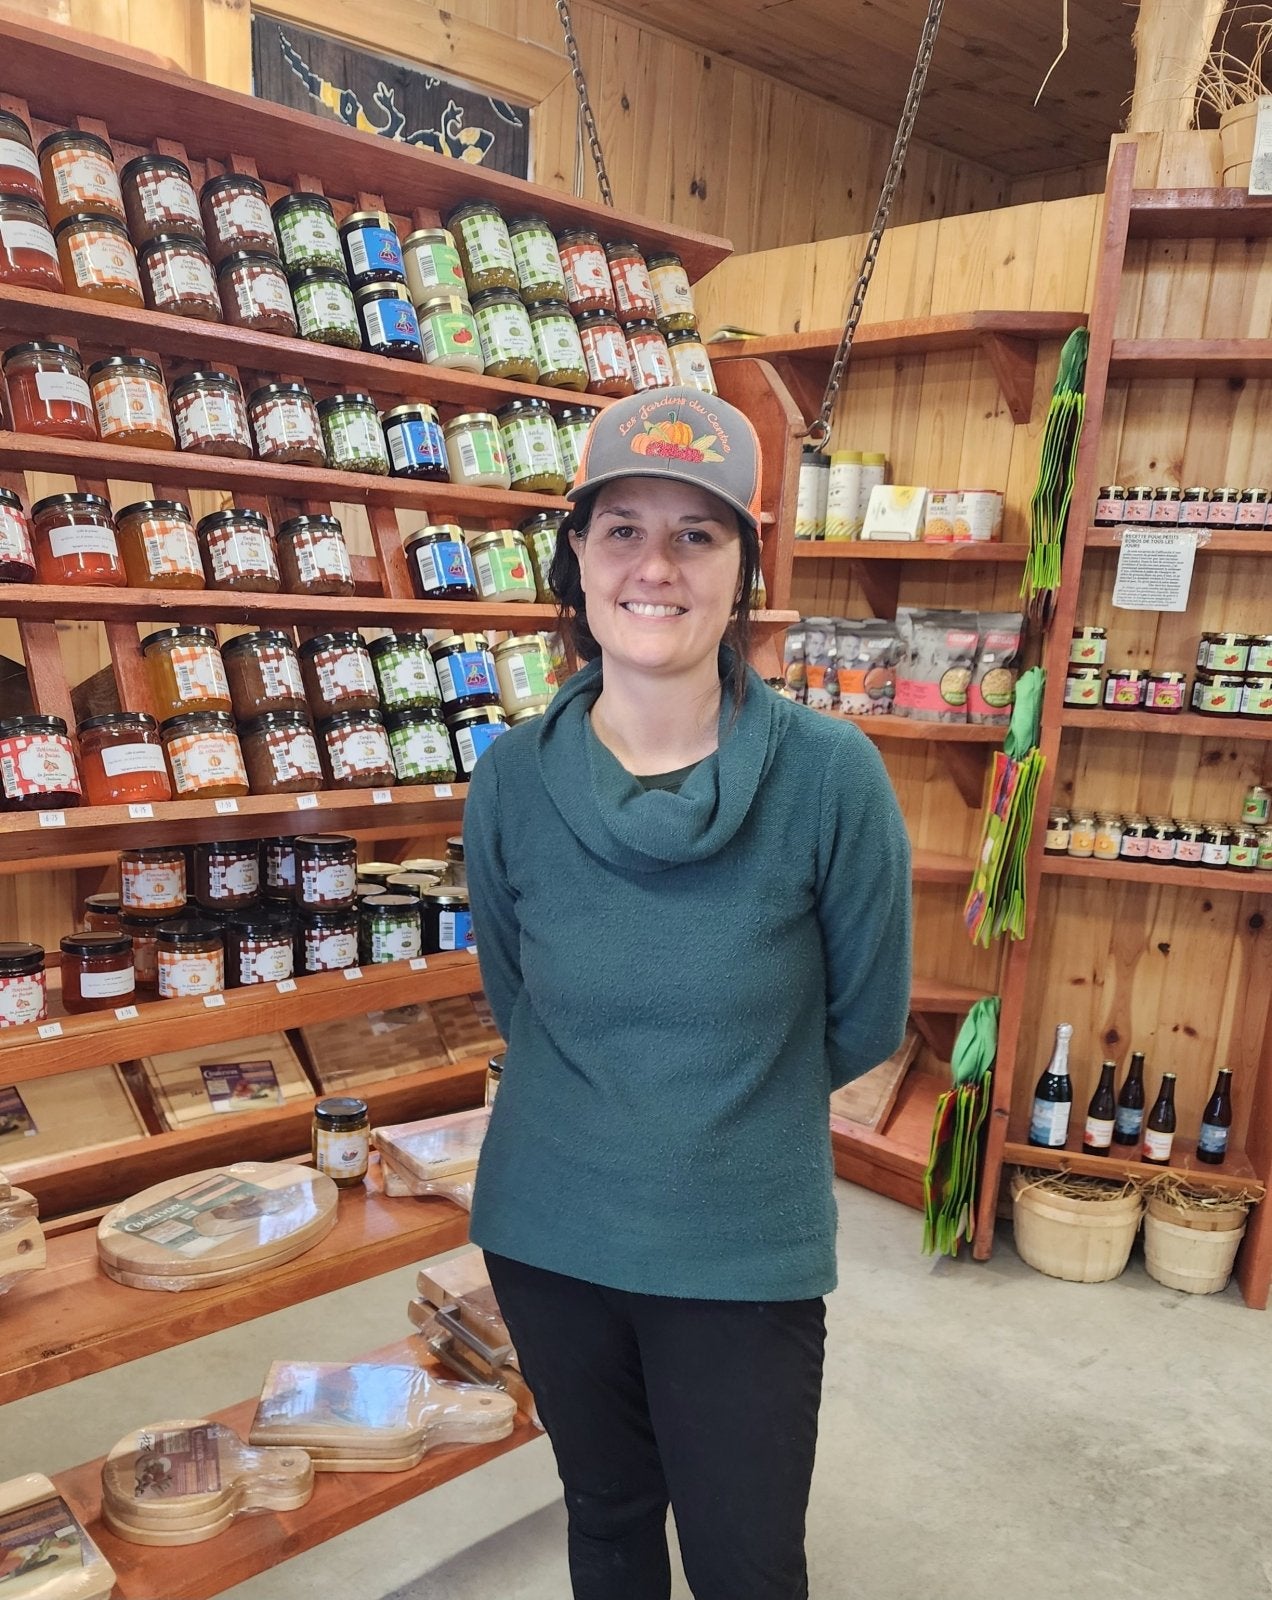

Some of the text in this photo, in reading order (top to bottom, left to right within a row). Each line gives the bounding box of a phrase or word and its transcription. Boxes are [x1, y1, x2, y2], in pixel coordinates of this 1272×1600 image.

[619, 395, 731, 454] Les Jardins du Centre
